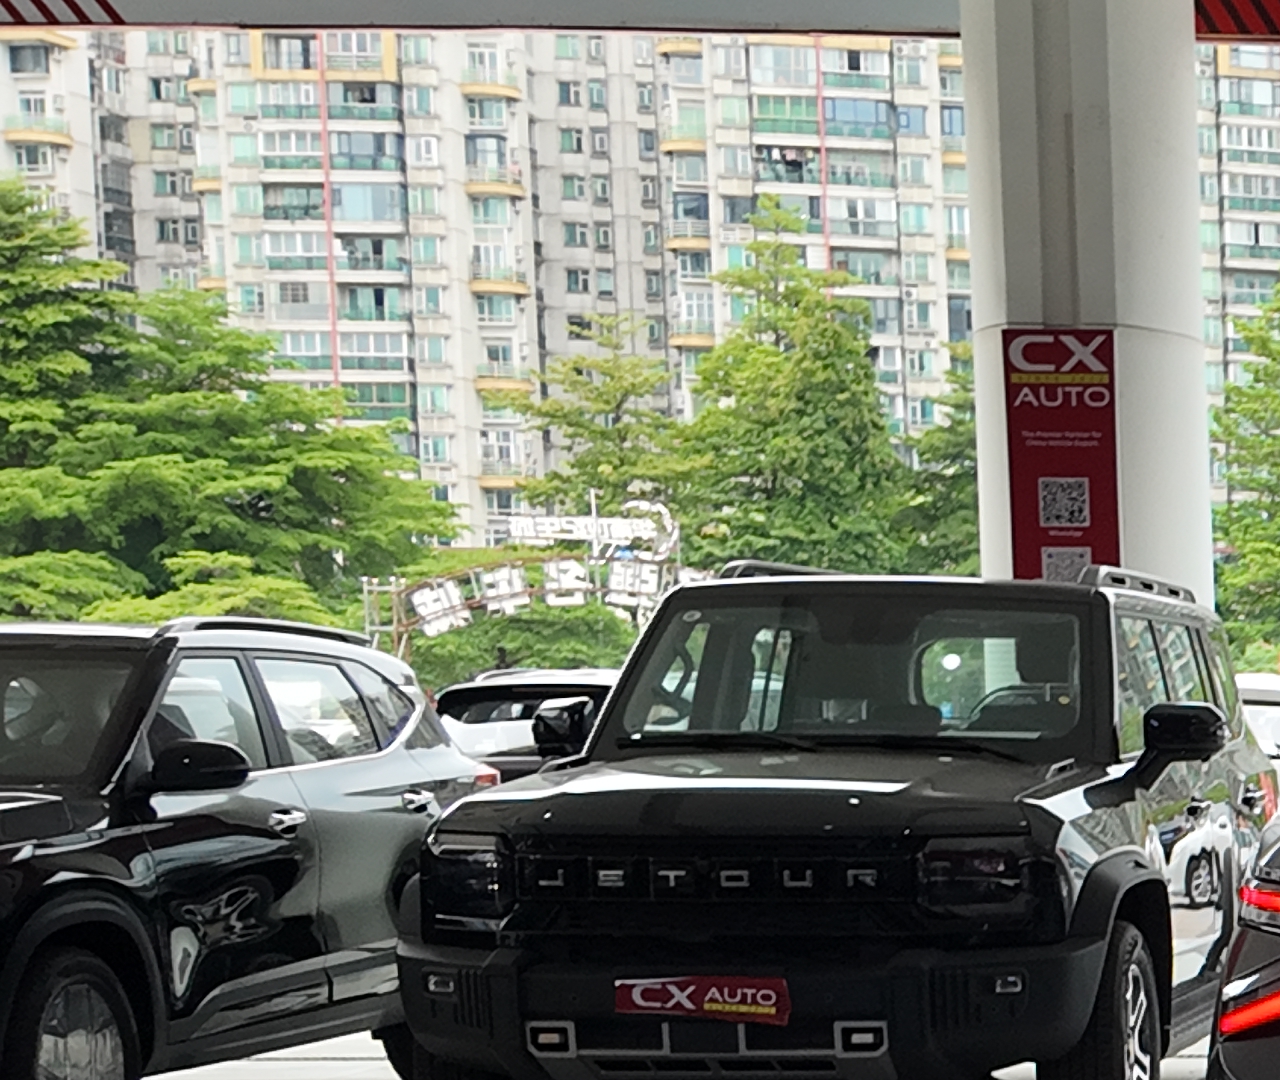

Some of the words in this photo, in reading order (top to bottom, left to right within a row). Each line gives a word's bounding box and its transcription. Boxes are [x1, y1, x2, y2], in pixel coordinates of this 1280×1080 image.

[1008, 334, 1108, 372] CX
[1013, 386, 1110, 407] AUTO
[538, 868, 878, 888] JETOUR
[631, 984, 697, 1010] CX
[704, 987, 776, 1005] AUTO
